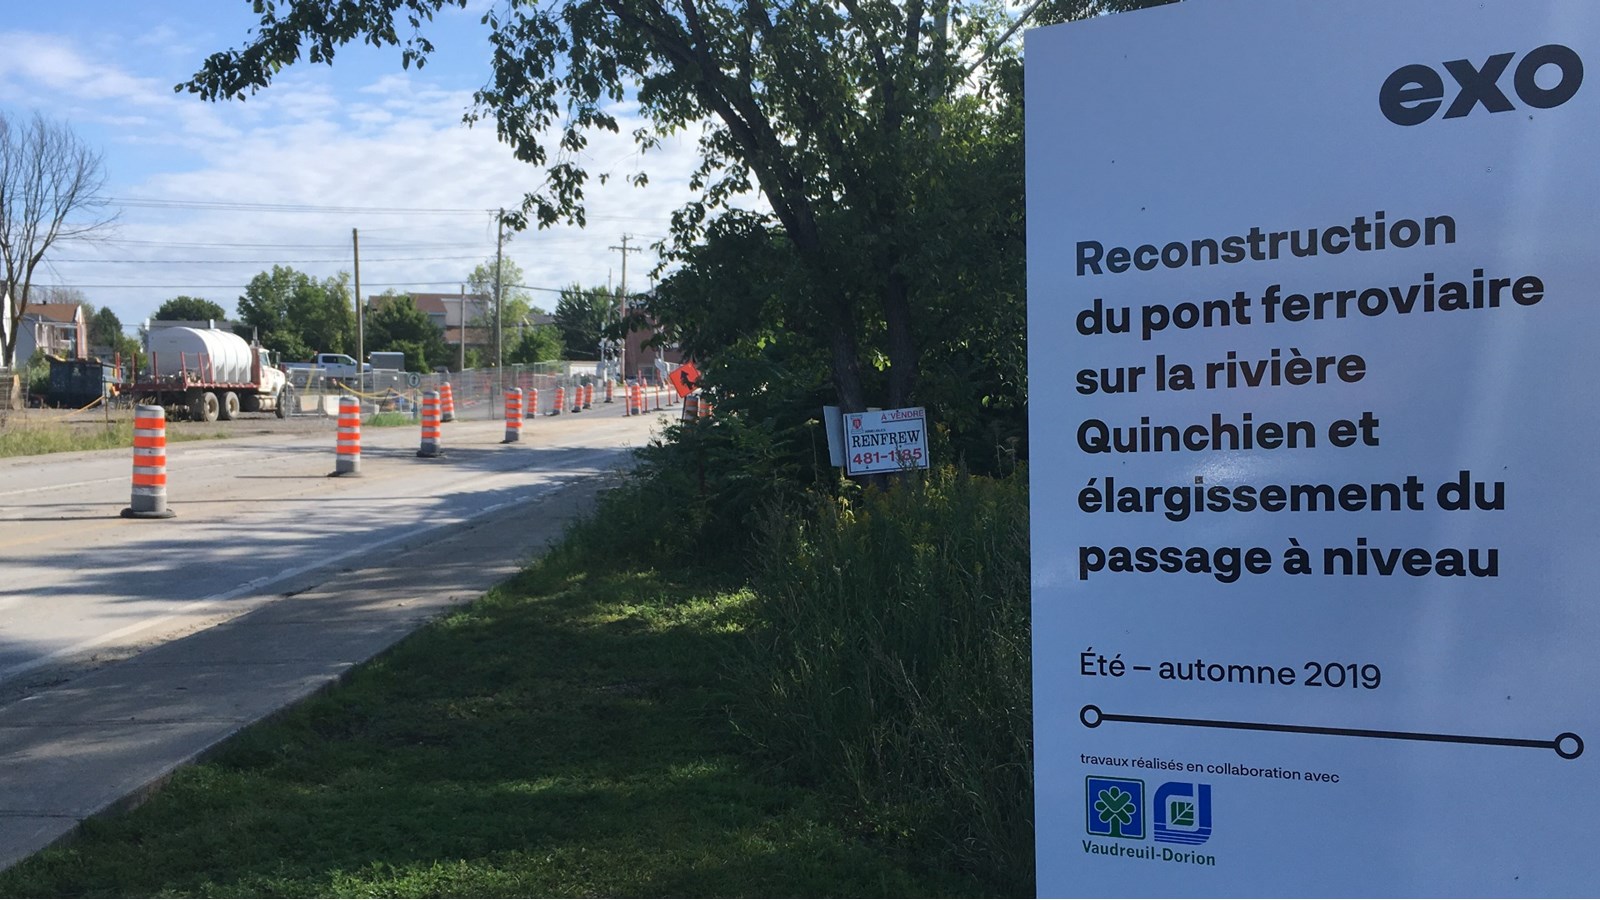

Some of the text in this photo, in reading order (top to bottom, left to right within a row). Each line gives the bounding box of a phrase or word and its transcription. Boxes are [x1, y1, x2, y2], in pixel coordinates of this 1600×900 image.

[1378, 43, 1584, 127] exo
[1076, 210, 1456, 277] Reconstruction
[1075, 268, 1545, 341] du pont ferroviaire
[1075, 347, 1367, 396] sur la rivière
[891, 410, 923, 420] VENDRE
[1076, 411, 1380, 455] Quinchien et
[851, 430, 920, 447] RENFREW
[1077, 469, 1505, 523] élargissement du
[1078, 537, 1499, 584] passage à niveau
[1080, 646, 1126, 678] Été
[1158, 658, 1296, 686] automne
[1303, 661, 1382, 690] 2019
[1080, 753, 1340, 784] travaux réalisés en collaboration avec
[1081, 838, 1216, 867] Vaudreuil-Dorion
